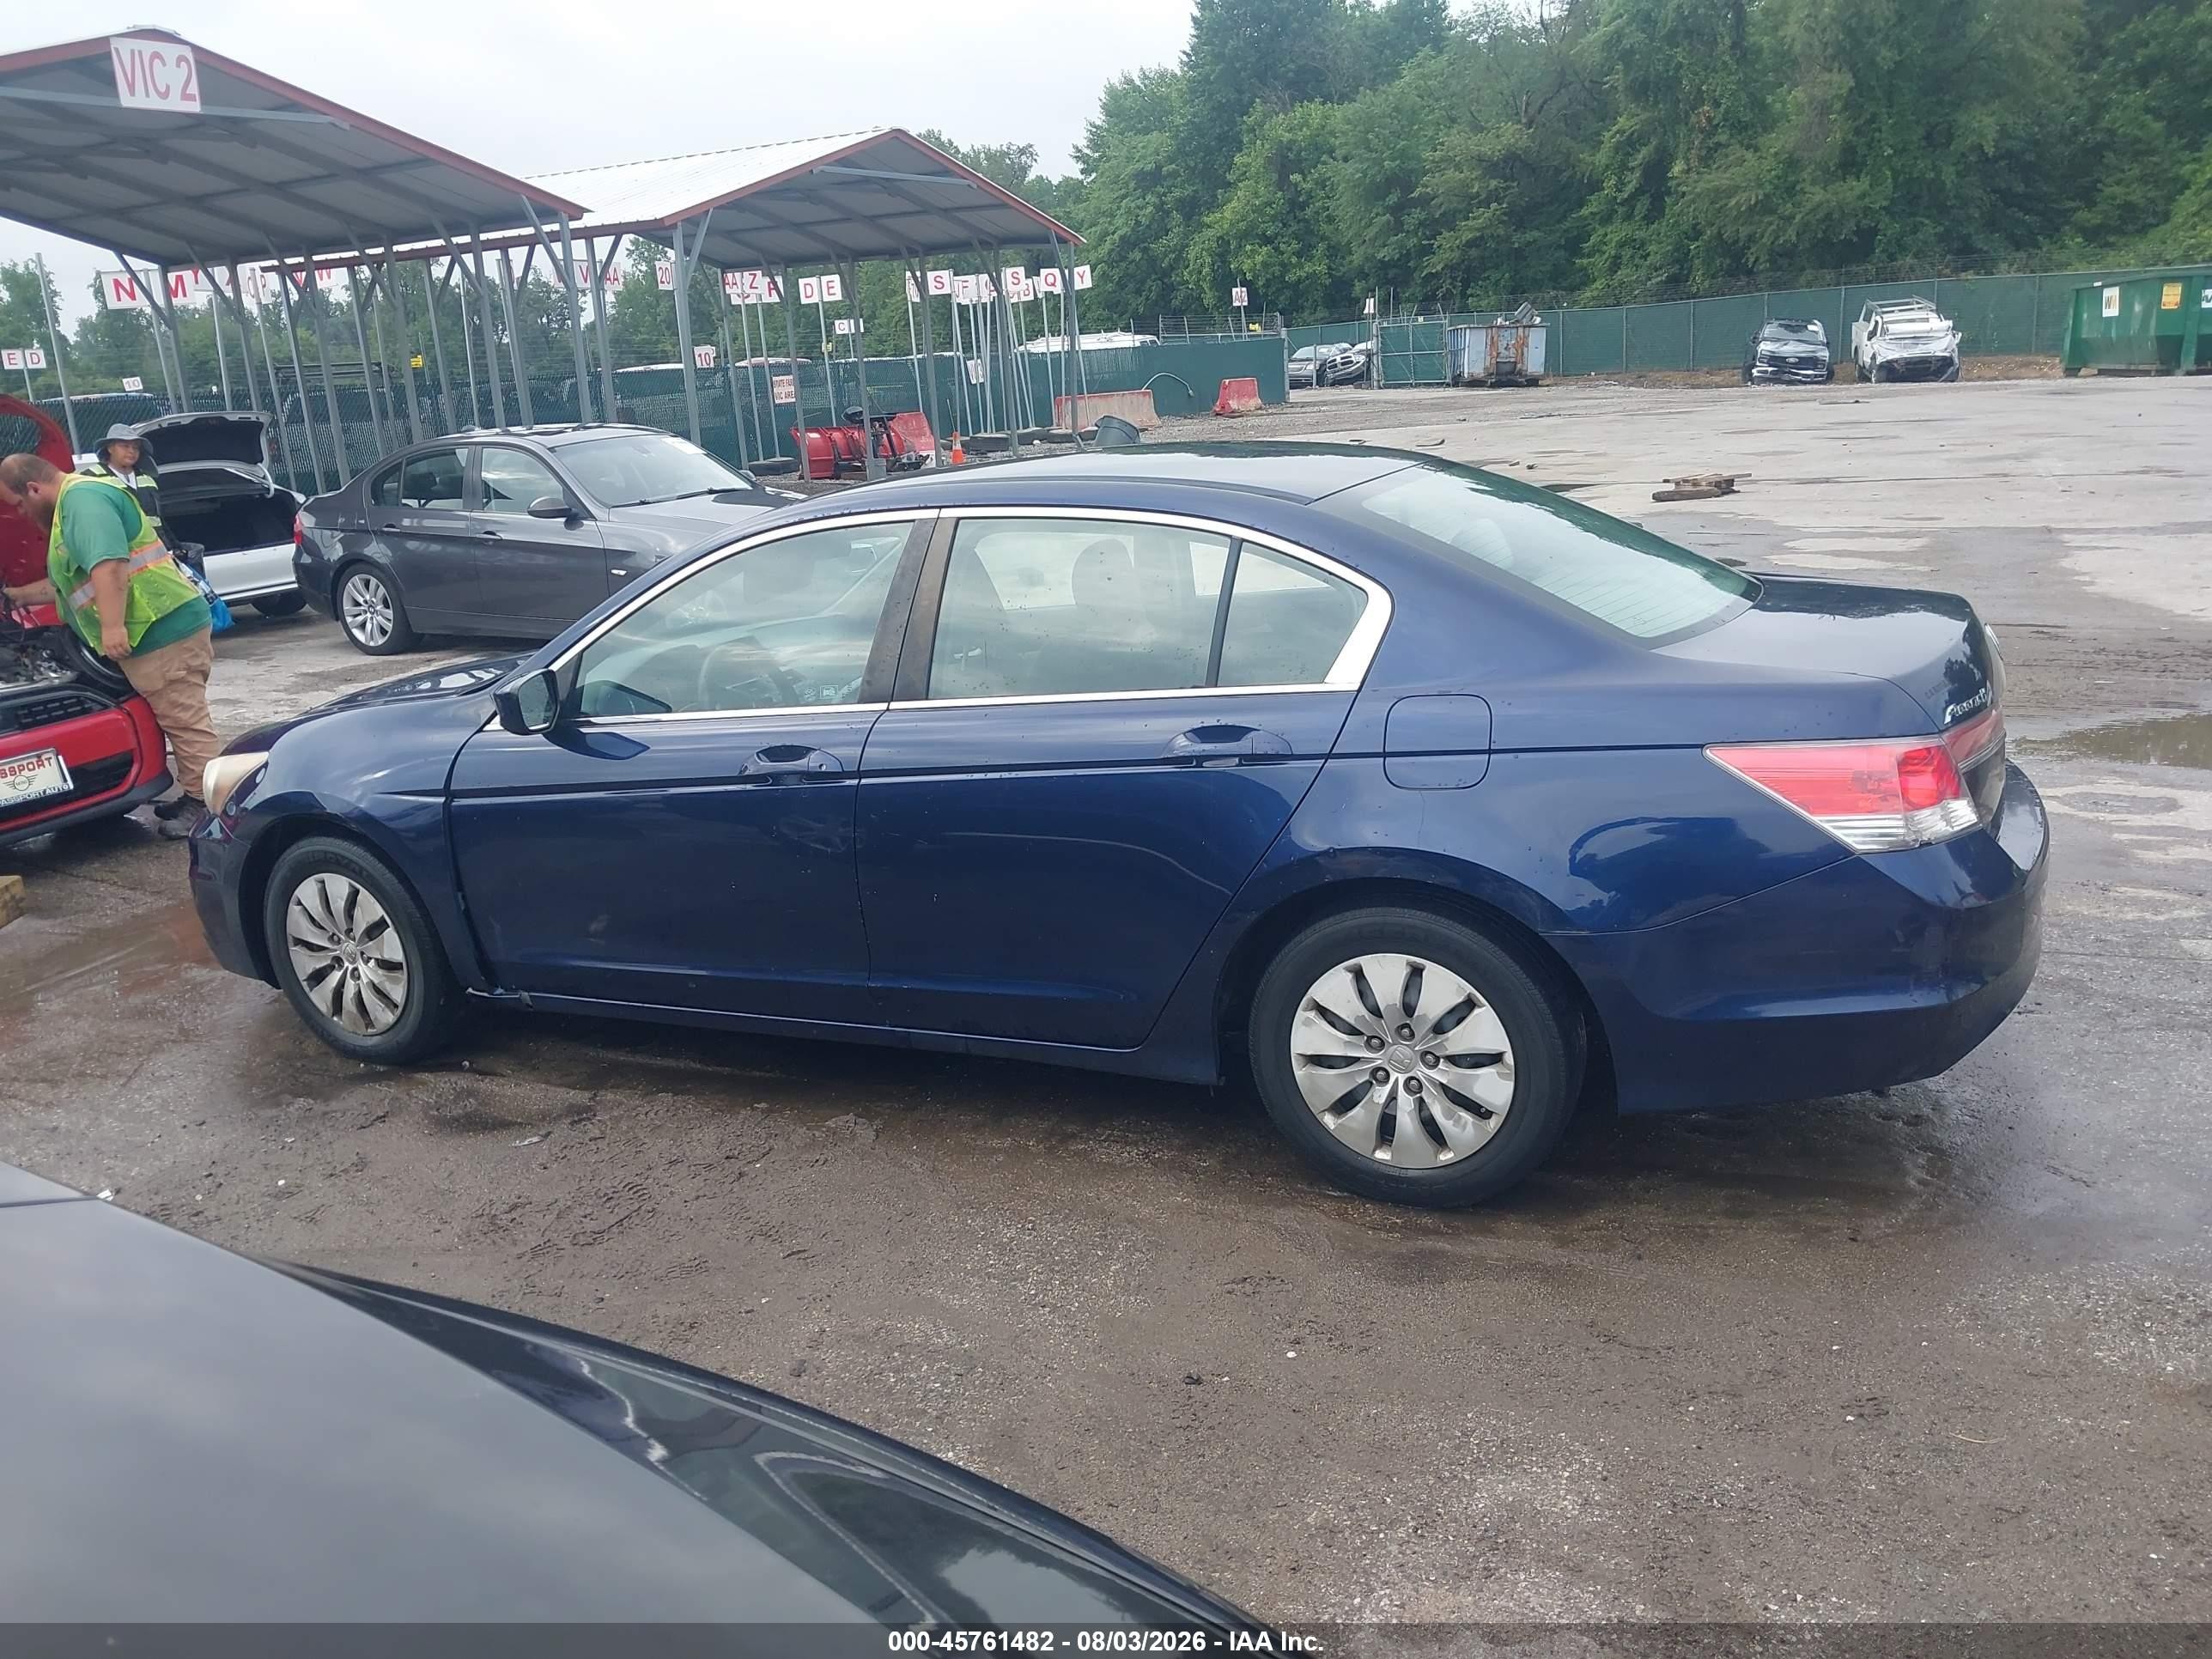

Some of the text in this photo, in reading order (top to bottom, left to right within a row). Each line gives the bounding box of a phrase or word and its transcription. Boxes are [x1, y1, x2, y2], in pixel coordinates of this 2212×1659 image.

[113, 46, 197, 102] VIC 2
[659, 267, 671, 284] 20
[749, 273, 758, 289] Z
[933, 275, 945, 289] S
[1011, 271, 1021, 286] S
[1044, 272, 1057, 288] Q
[1077, 270, 1086, 284] Y
[112, 277, 137, 301] N
[804, 283, 814, 298] D
[827, 280, 836, 296] E
[838, 322, 846, 331] C
[8, 352, 17, 365] E
[30, 352, 40, 365] D
[697, 352, 712, 368] 10
[125, 379, 140, 388] 10
[784, 390, 794, 399] ARE
